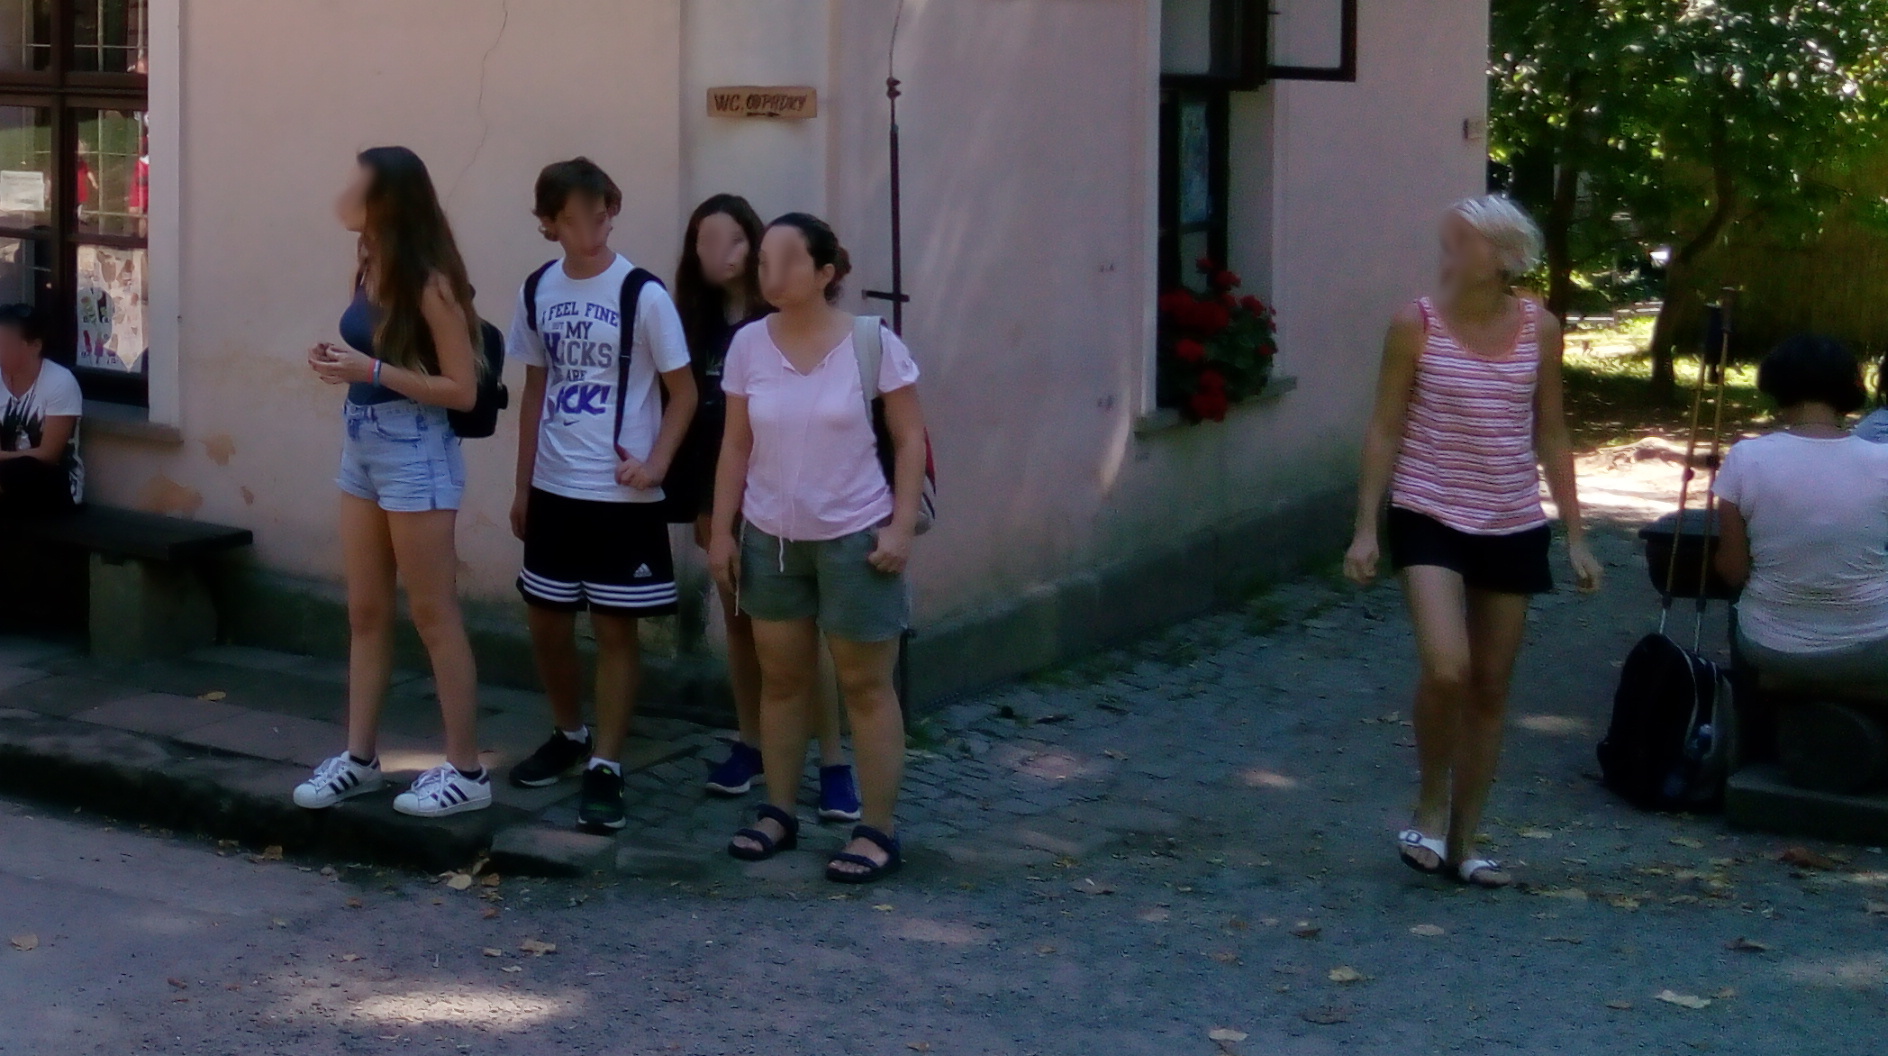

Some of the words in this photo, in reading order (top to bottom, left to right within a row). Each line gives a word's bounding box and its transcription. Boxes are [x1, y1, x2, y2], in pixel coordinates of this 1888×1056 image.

[548, 301, 579, 321] FEEL
[585, 302, 620, 328] FINE
[565, 320, 593, 340] MY
[566, 369, 587, 382] ARE
